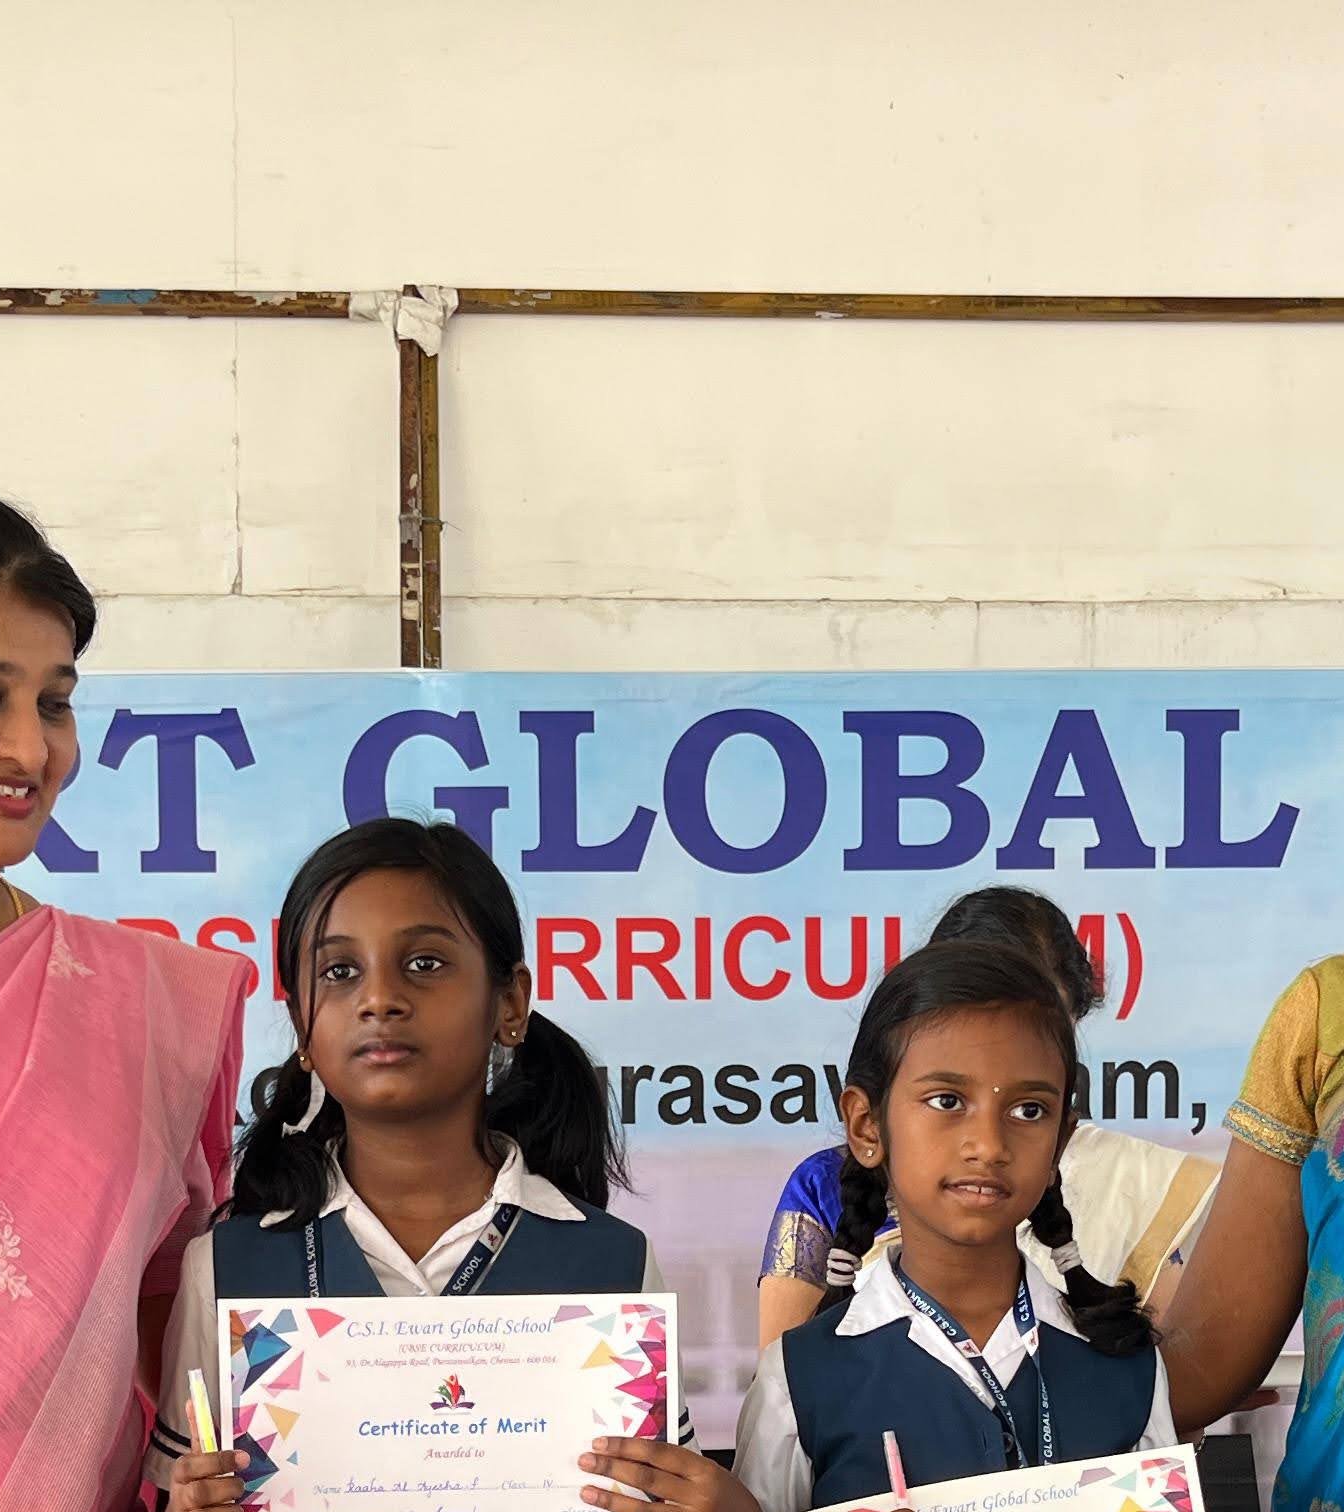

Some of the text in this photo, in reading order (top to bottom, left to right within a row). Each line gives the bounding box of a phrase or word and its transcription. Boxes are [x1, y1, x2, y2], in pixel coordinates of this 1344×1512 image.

[342, 708, 1301, 875] GLOBAL
[304, 1221, 316, 1260] SCHOOL
[452, 1256, 483, 1292] SCHOOL
[346, 1318, 555, 1339] C.S.I. Ewart Global School
[980, 1366, 1008, 1407] SCHOOL
[358, 1417, 547, 1436] Certificate of Merit
[1043, 1412, 1053, 1458] GLOBAL
[424, 1447, 485, 1461] Awarded to
[312, 1484, 342, 1495] Name
[501, 1480, 528, 1491] Class
[1033, 1481, 1081, 1504] School
